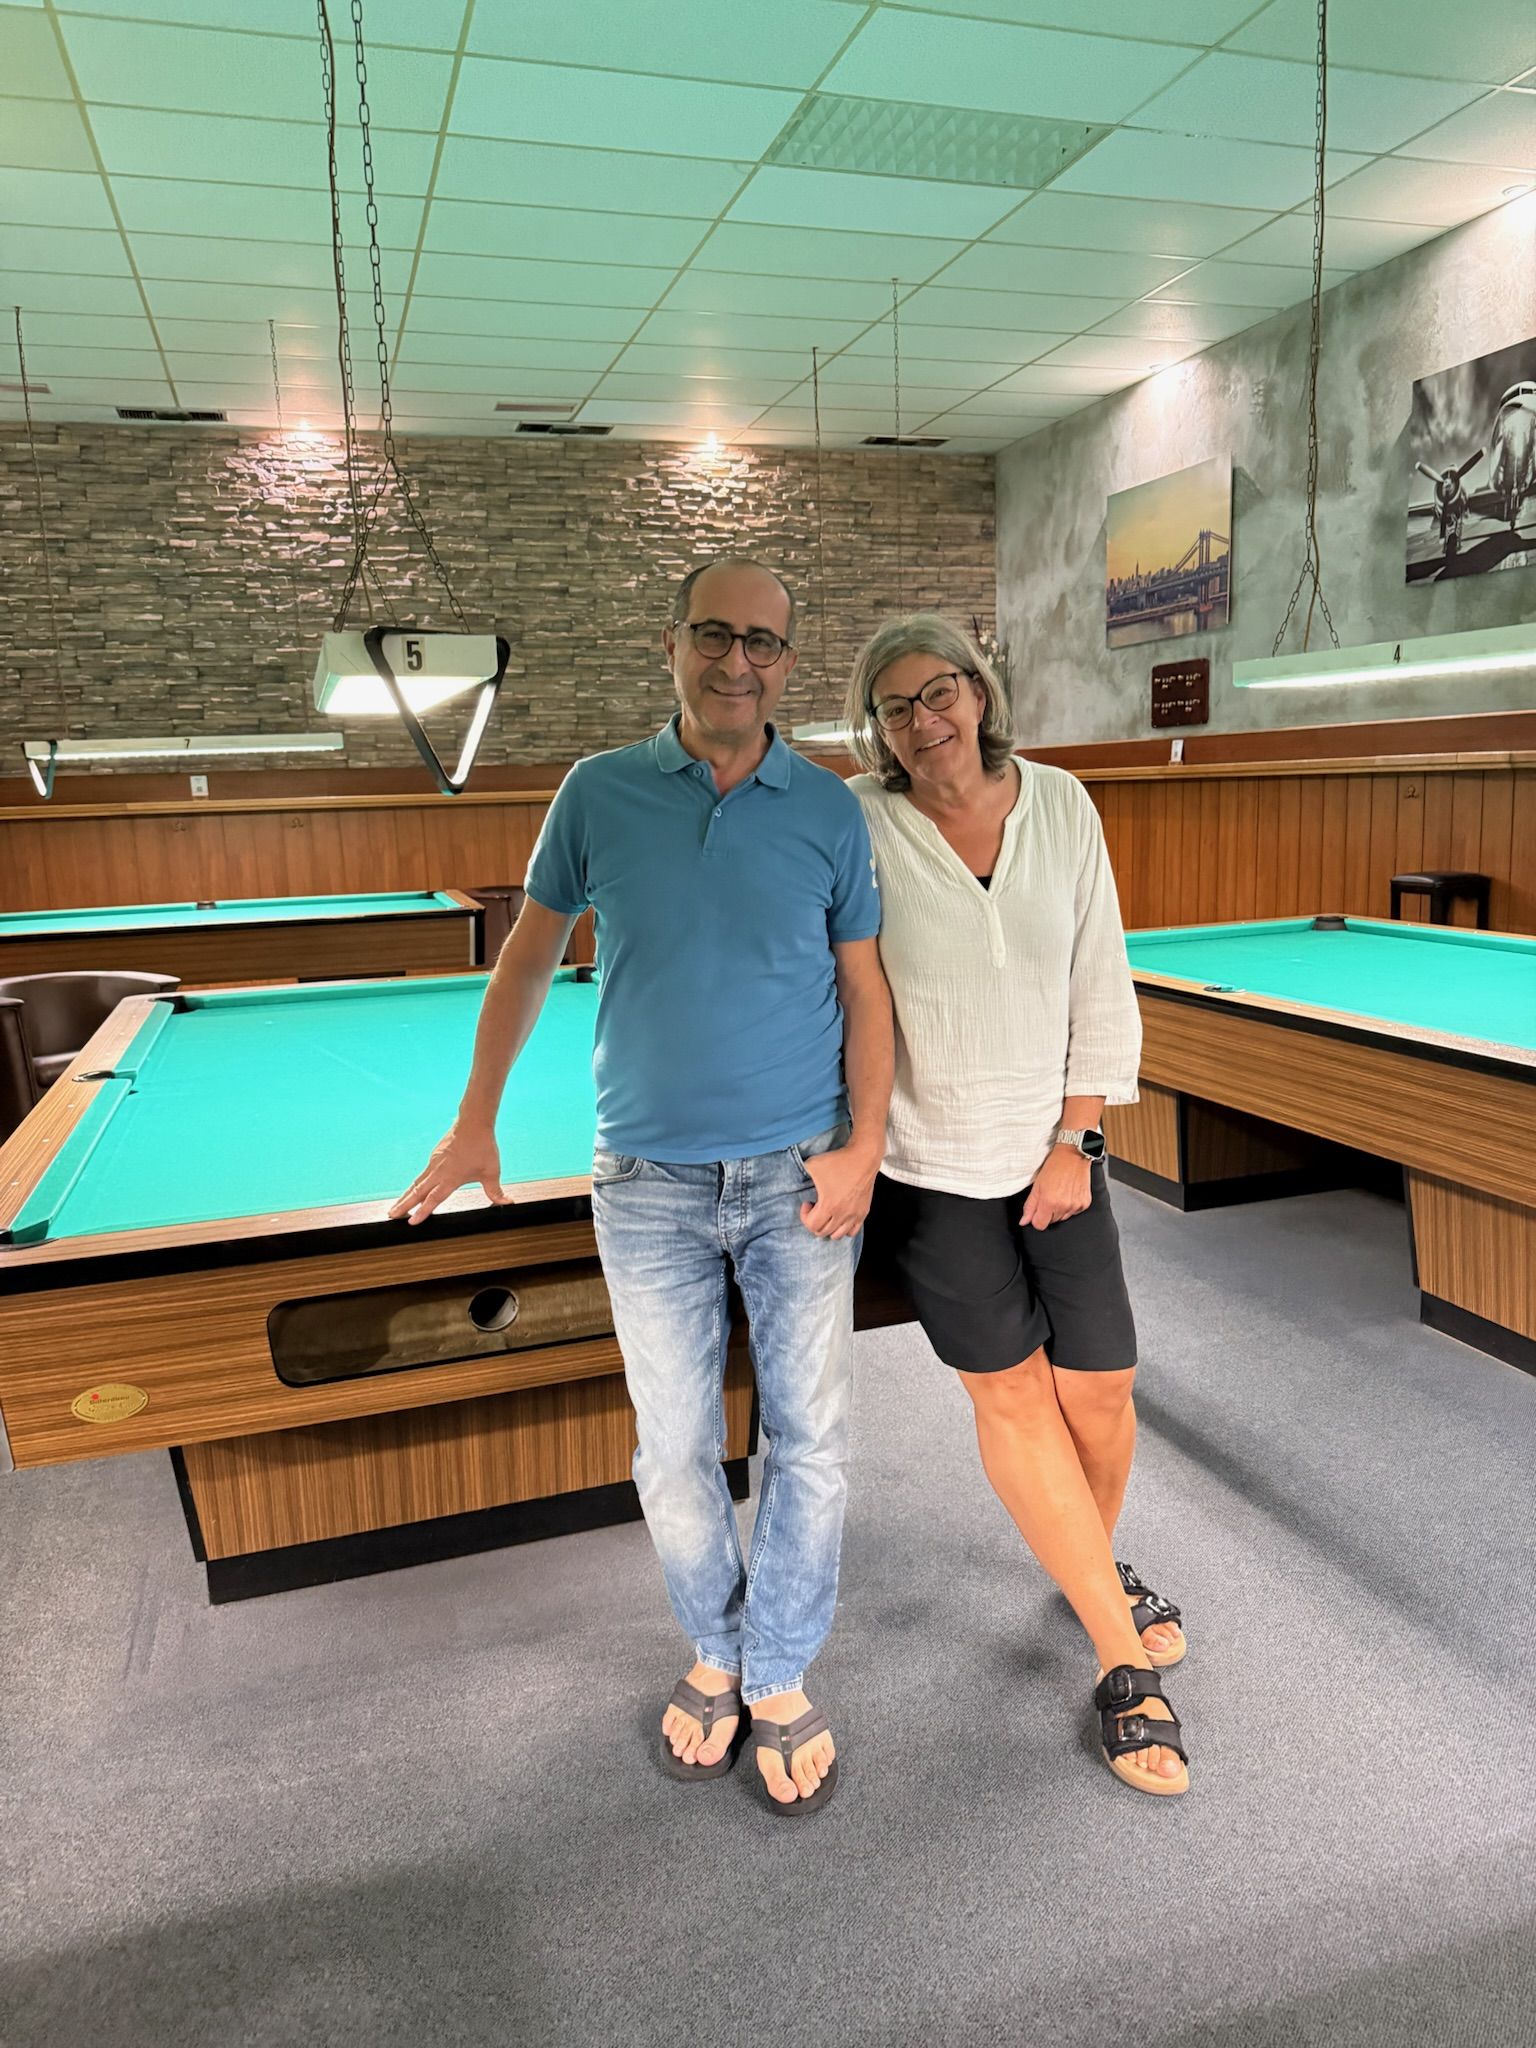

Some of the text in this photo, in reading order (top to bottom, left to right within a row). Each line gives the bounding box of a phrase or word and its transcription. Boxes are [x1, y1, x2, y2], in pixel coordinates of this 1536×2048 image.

[406, 640, 423, 671] 5
[1393, 644, 1401, 664] 4
[184, 738, 191, 750] 7
